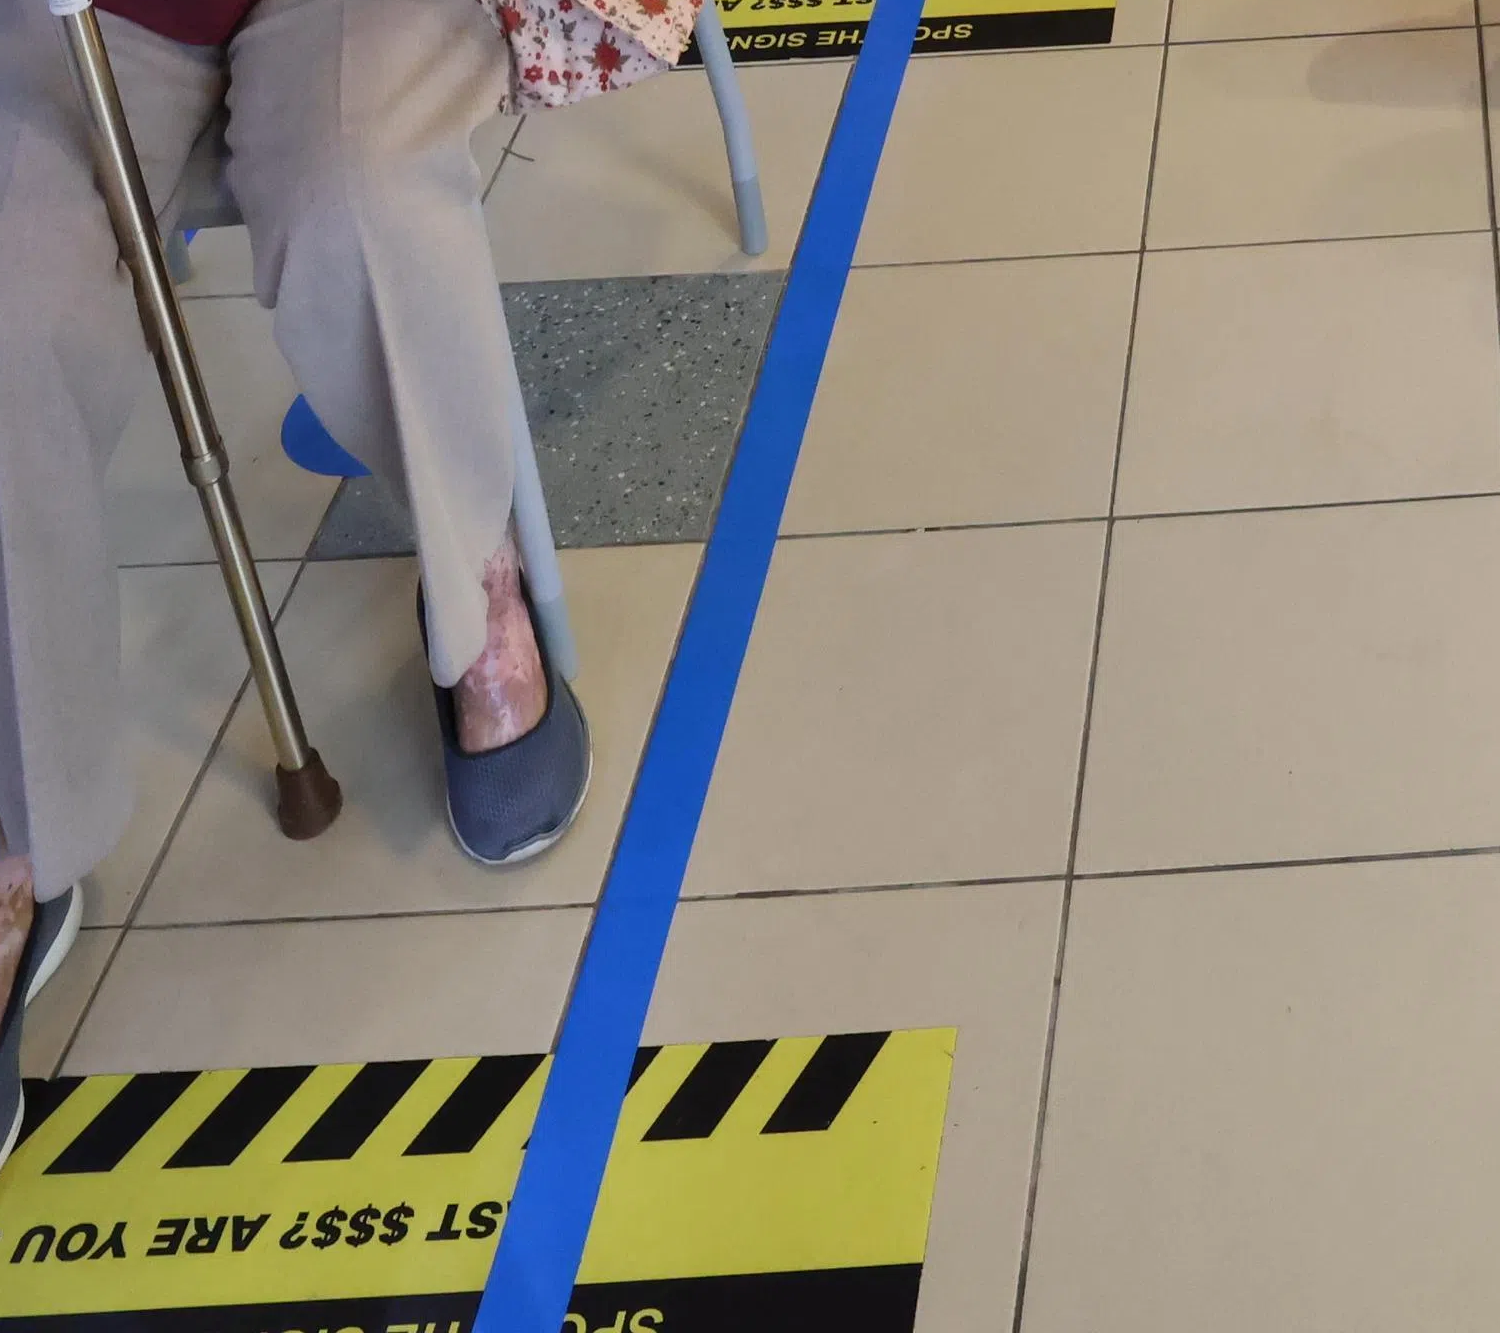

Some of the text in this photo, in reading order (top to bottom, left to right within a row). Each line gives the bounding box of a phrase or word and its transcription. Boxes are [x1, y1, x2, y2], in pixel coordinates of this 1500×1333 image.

[815, 29, 864, 46] HE
[9, 1221, 128, 1264] YOU
[146, 1214, 272, 1258] ARE
[279, 1201, 415, 1250] $$$?
